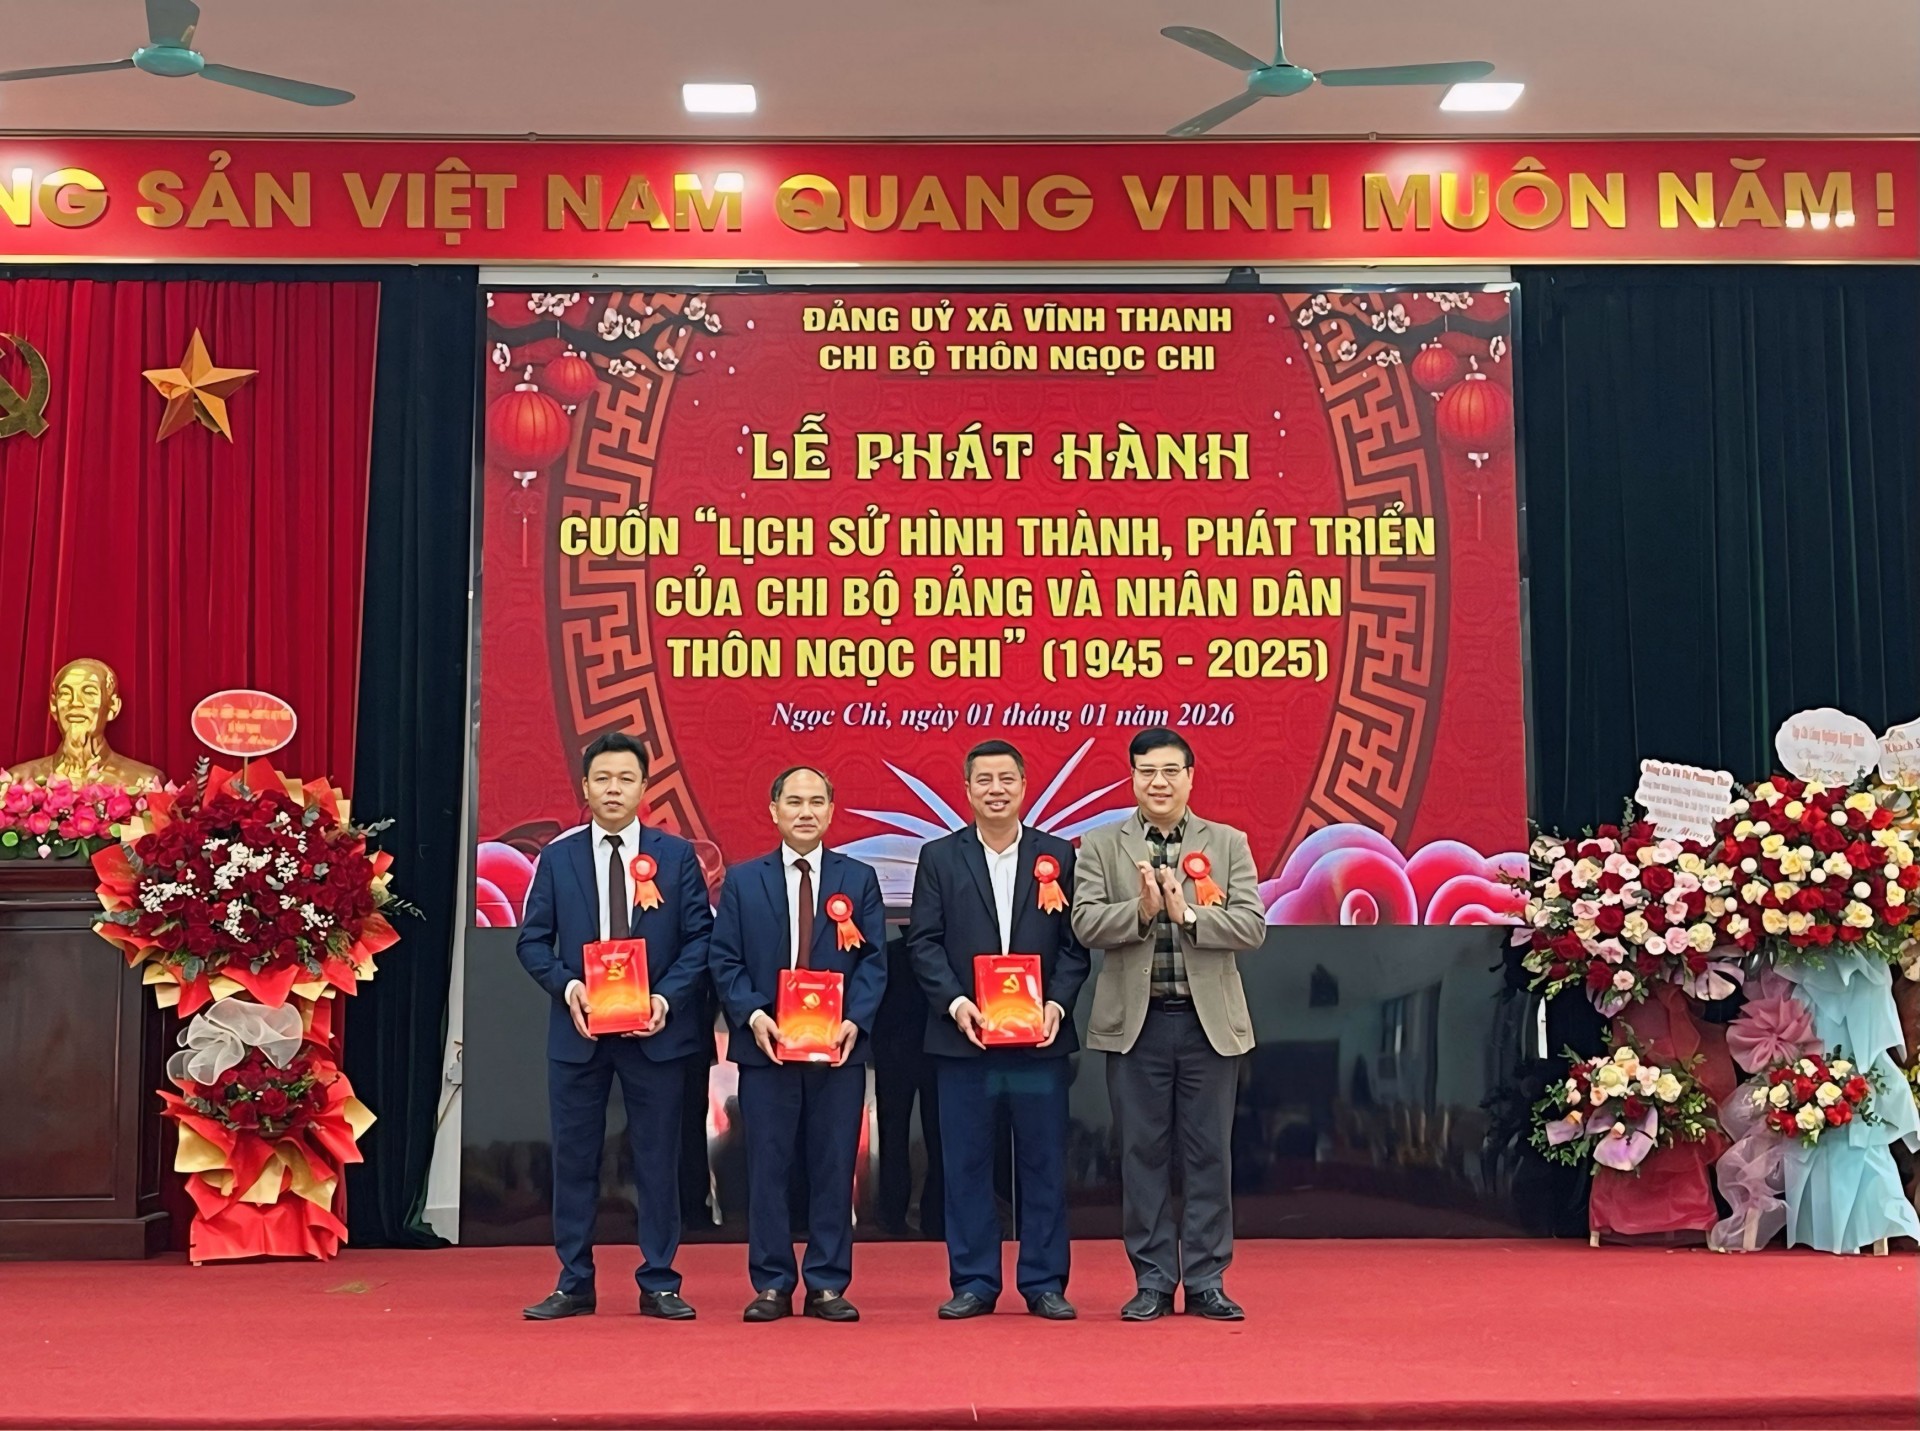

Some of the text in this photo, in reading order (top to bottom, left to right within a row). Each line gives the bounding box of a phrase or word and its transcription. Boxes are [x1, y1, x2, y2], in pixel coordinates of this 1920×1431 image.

[136, 149, 311, 229] SẢN
[342, 157, 517, 246] VIỆT
[547, 171, 746, 232] NAM
[774, 173, 1094, 232] QUANG
[1122, 173, 1332, 231] VINH
[1363, 155, 1627, 231] MUÔN
[802, 299, 1232, 333] ĐẢNG UỶ XÃ VĨNH THANH
[819, 340, 1215, 377] CHI BỘ THÔN NGỌC CHI
[751, 413, 1250, 480] LỄ PHÁT HÀNH
[559, 500, 1436, 565] CUỐN “LỊCH SỬ HÌNH THÀNH, PHÁT TRIỂN
[655, 565, 1342, 626] CỦA CHI BỘ ĐẢNG VÀ NHÂN DÂN
[666, 630, 781, 679] THÔN
[796, 638, 915, 687] NGỌC
[930, 628, 1026, 679] CHI”
[1043, 639, 1163, 683] (1945
[1207, 638, 1329, 683] 2025)
[771, 702, 1236, 733] Ngọc Chi, ngày 01 tháng 01 năm 2026
